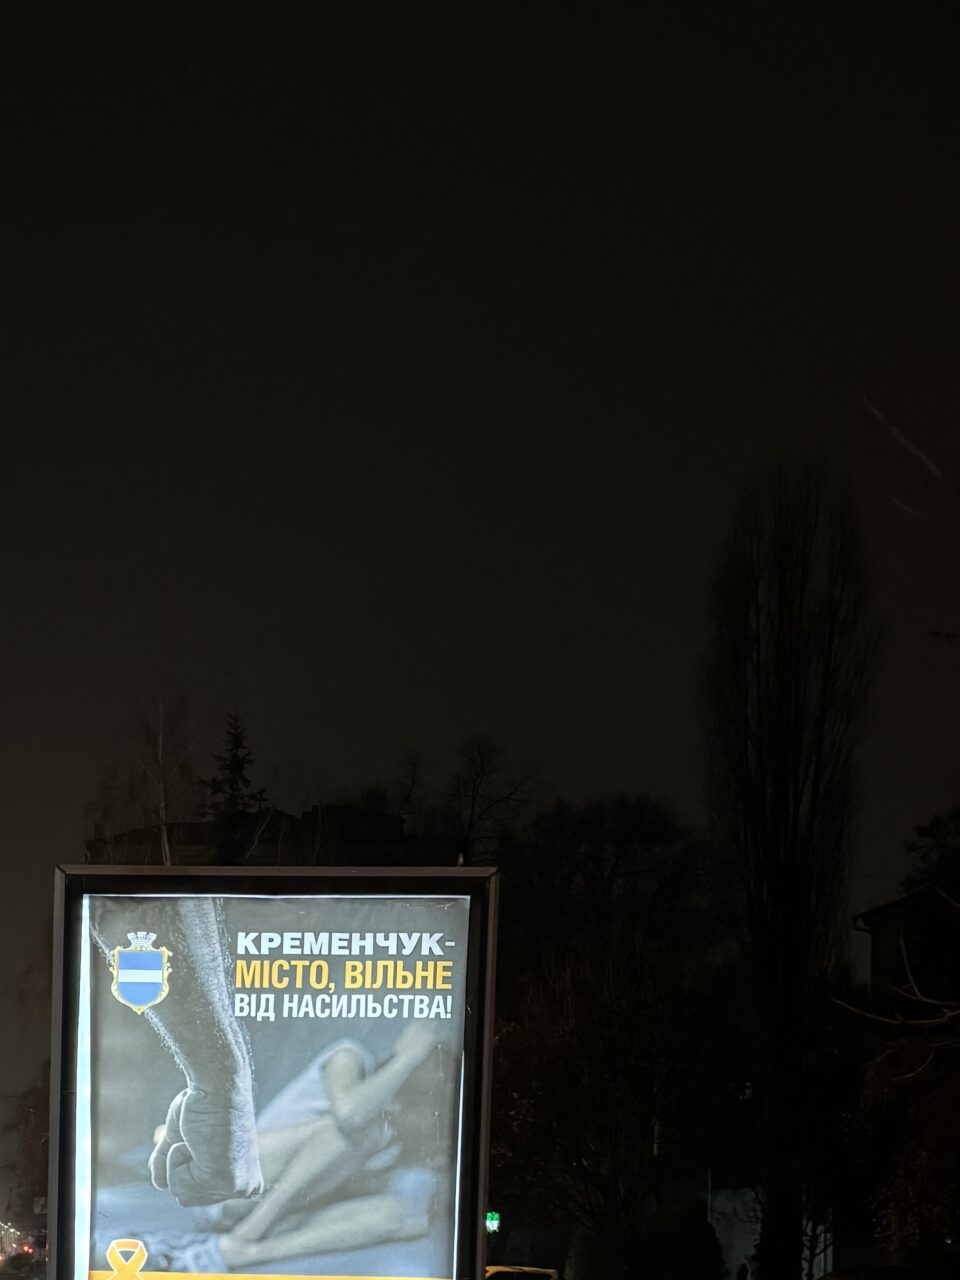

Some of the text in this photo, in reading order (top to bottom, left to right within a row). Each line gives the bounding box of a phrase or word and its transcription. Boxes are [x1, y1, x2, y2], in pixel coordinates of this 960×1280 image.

[236, 931, 456, 956] КРЕМЕНЧУК-
[234, 959, 454, 993] МІСТО, ВІЛЬНЕ
[234, 993, 453, 1022] ВІД НАСИЛЬСТВА!
